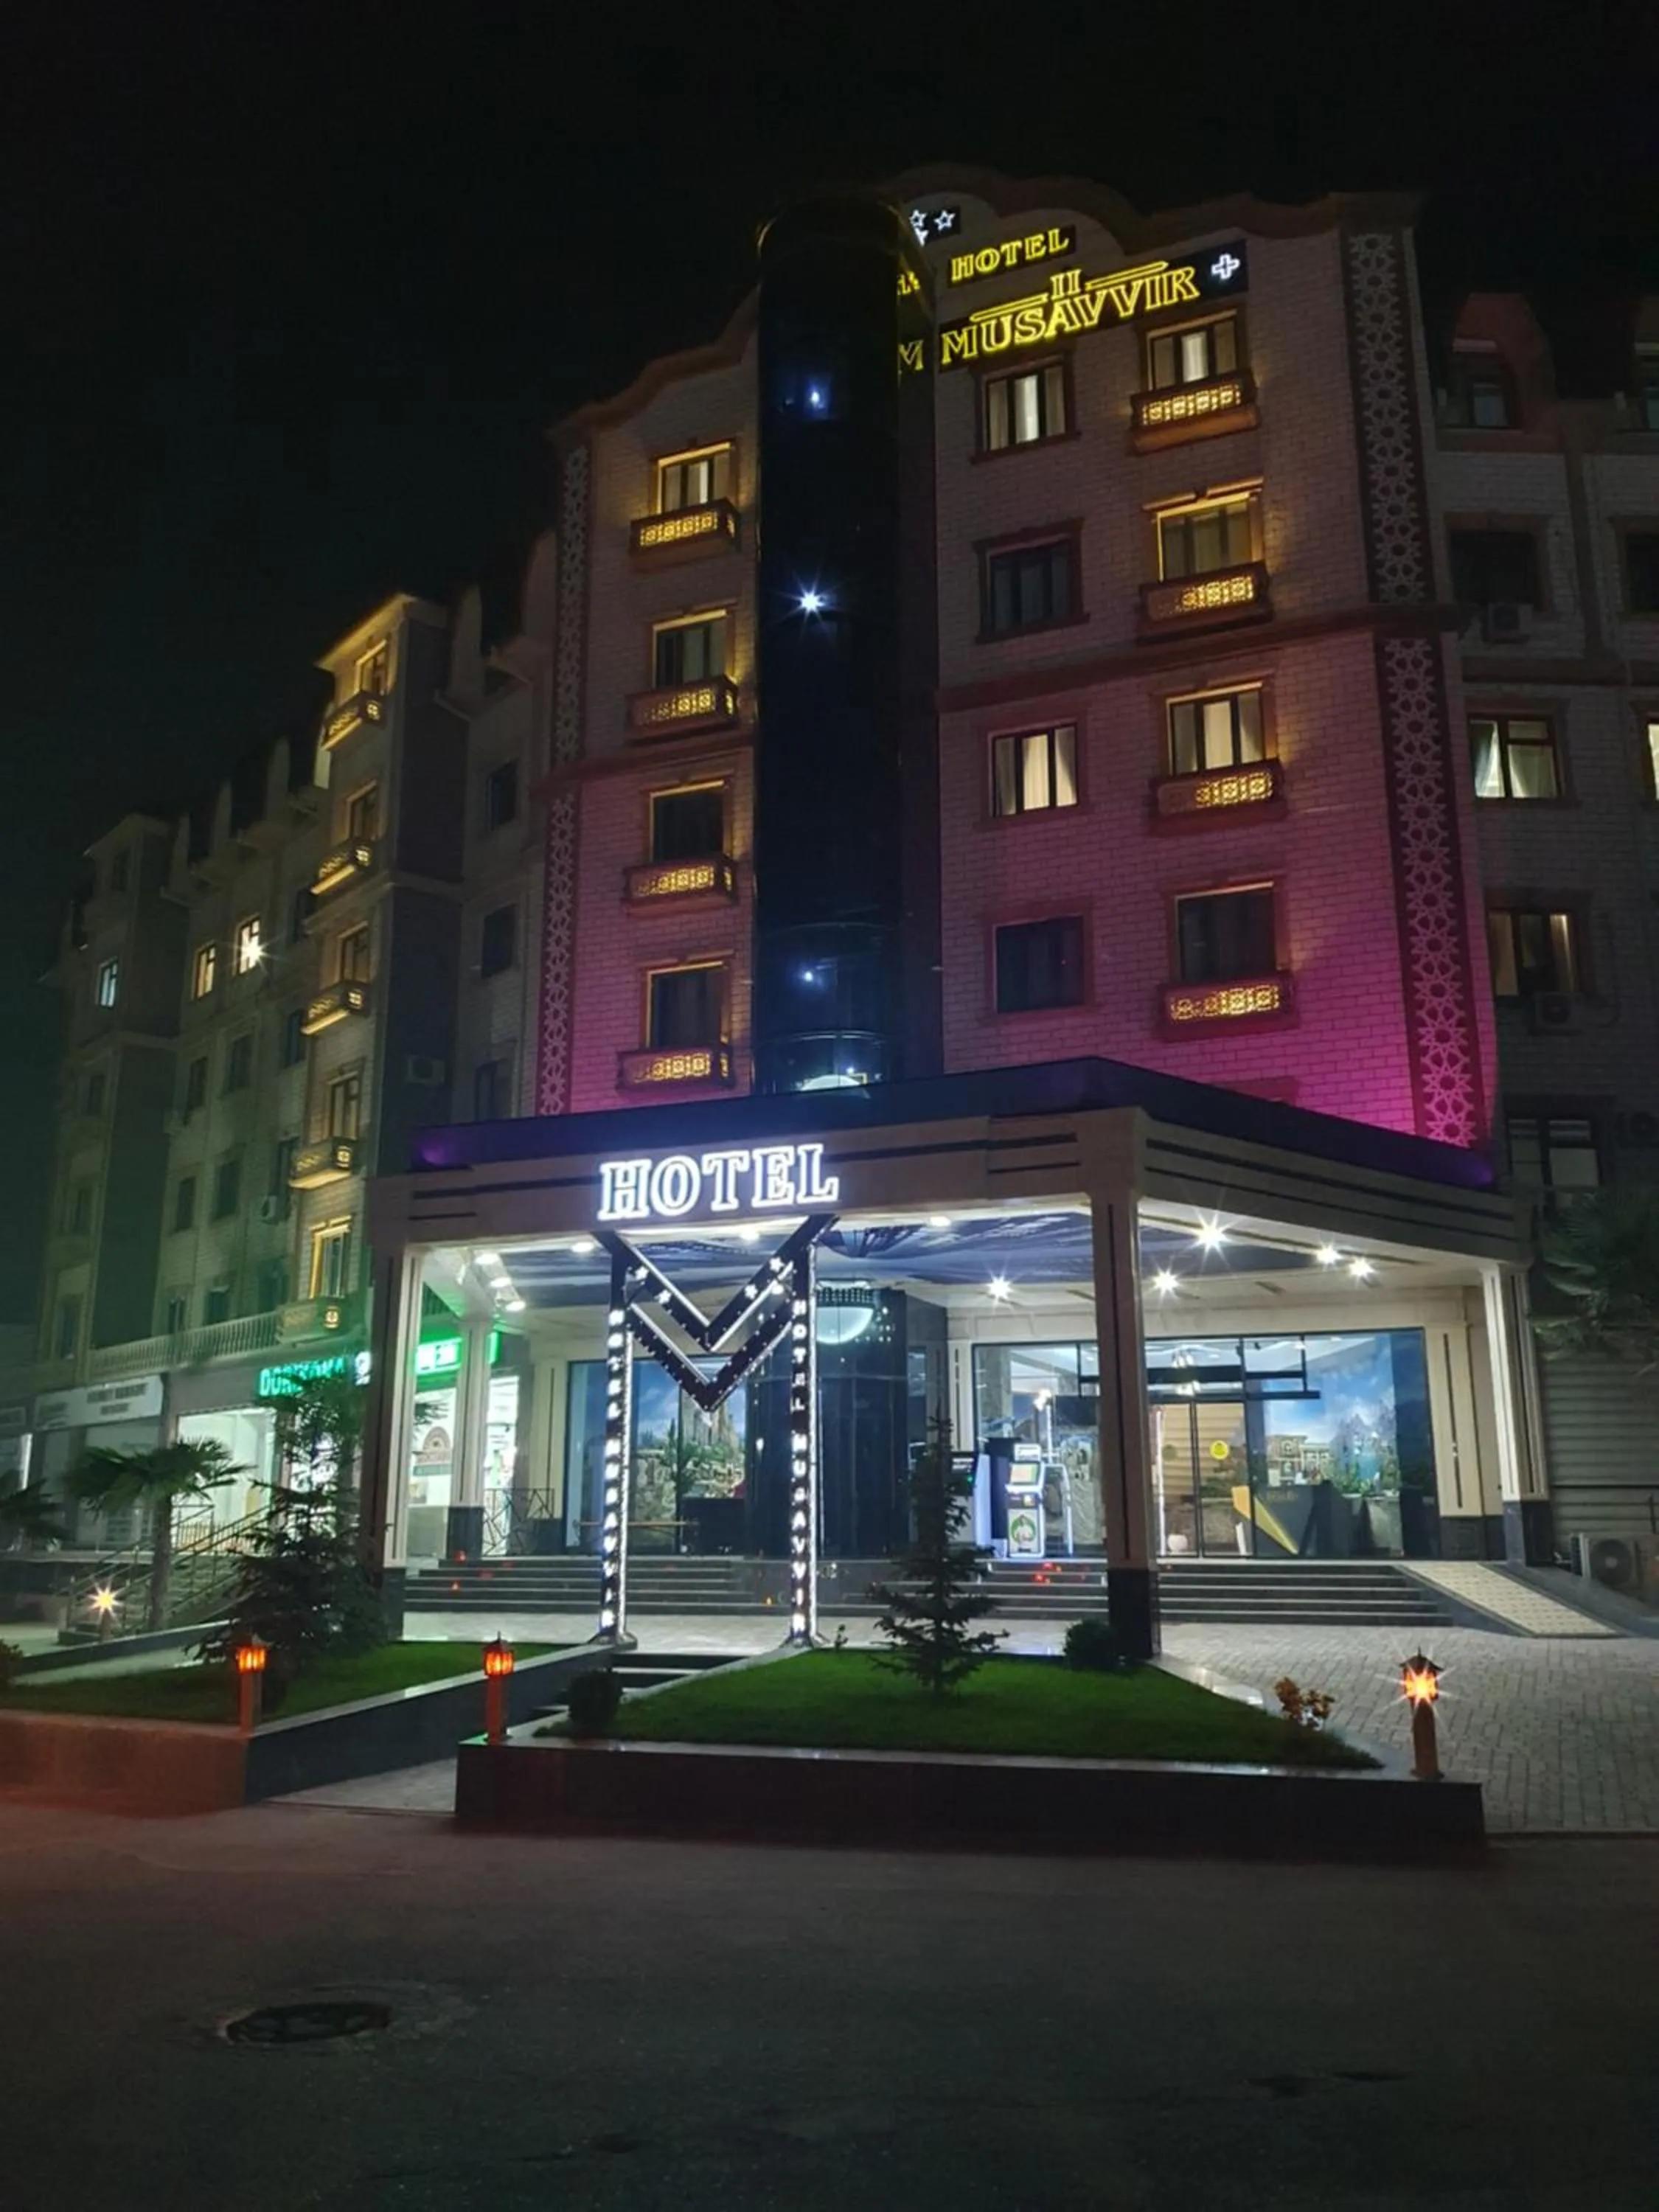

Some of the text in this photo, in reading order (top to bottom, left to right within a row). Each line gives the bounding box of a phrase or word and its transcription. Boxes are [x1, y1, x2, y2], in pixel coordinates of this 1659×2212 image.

[951, 228, 1069, 282] HOTEL
[941, 266, 1200, 365] MUSAVVIR
[597, 1144, 839, 1221] HOTEL
[793, 1299, 807, 1409] HOTEL
